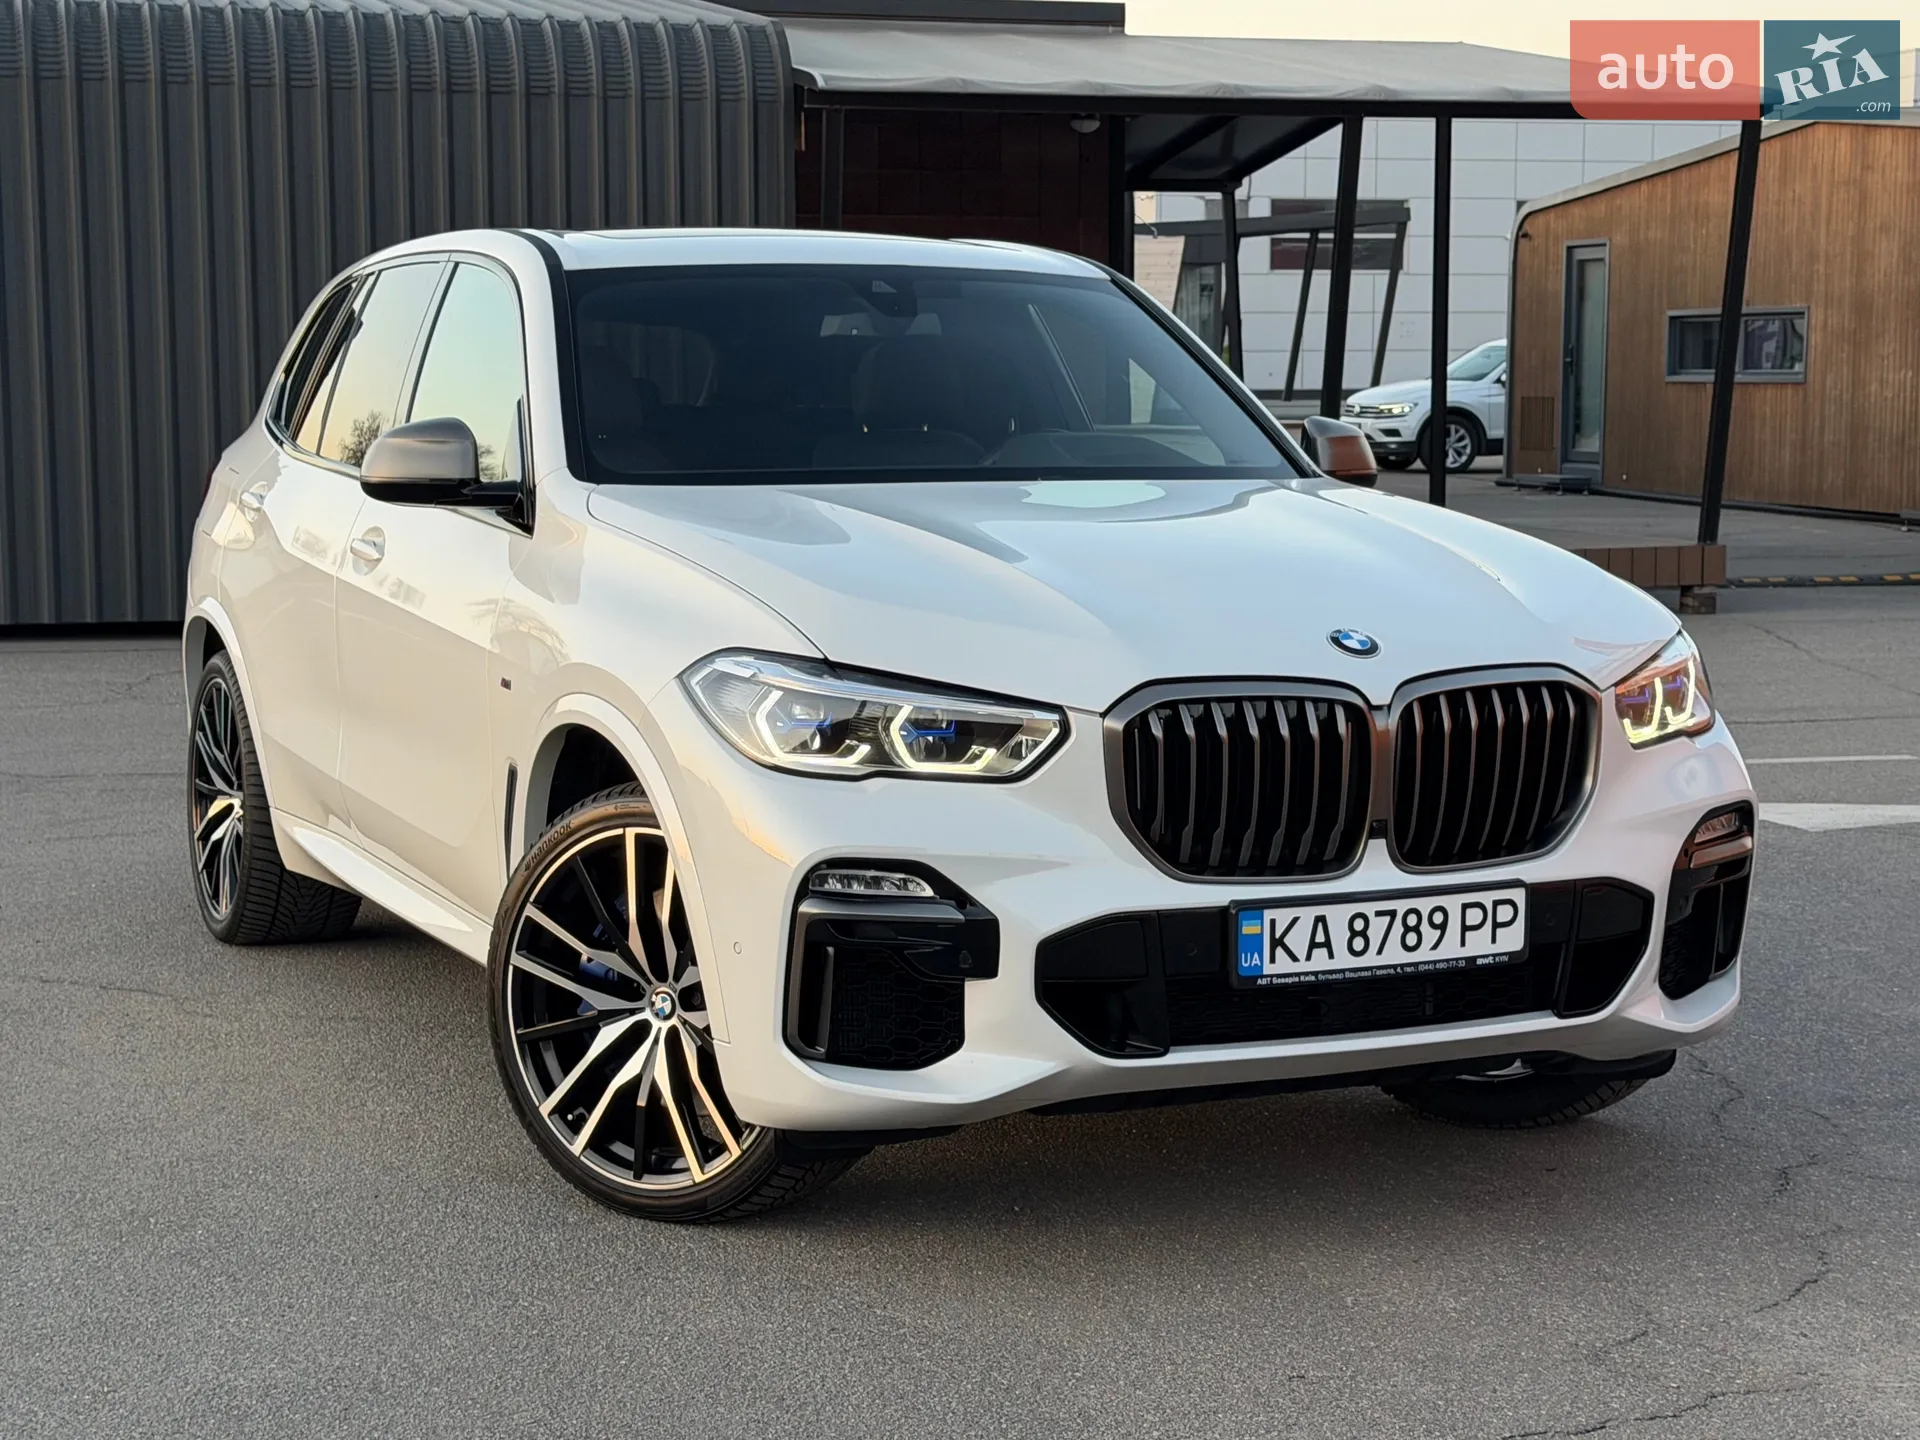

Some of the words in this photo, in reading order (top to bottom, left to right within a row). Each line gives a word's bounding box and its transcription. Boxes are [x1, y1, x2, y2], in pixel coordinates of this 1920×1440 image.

[1268, 914, 1335, 965] KA
[1346, 905, 1450, 958] 8789
[1460, 898, 1519, 948] PP
[1241, 952, 1261, 968] UA
